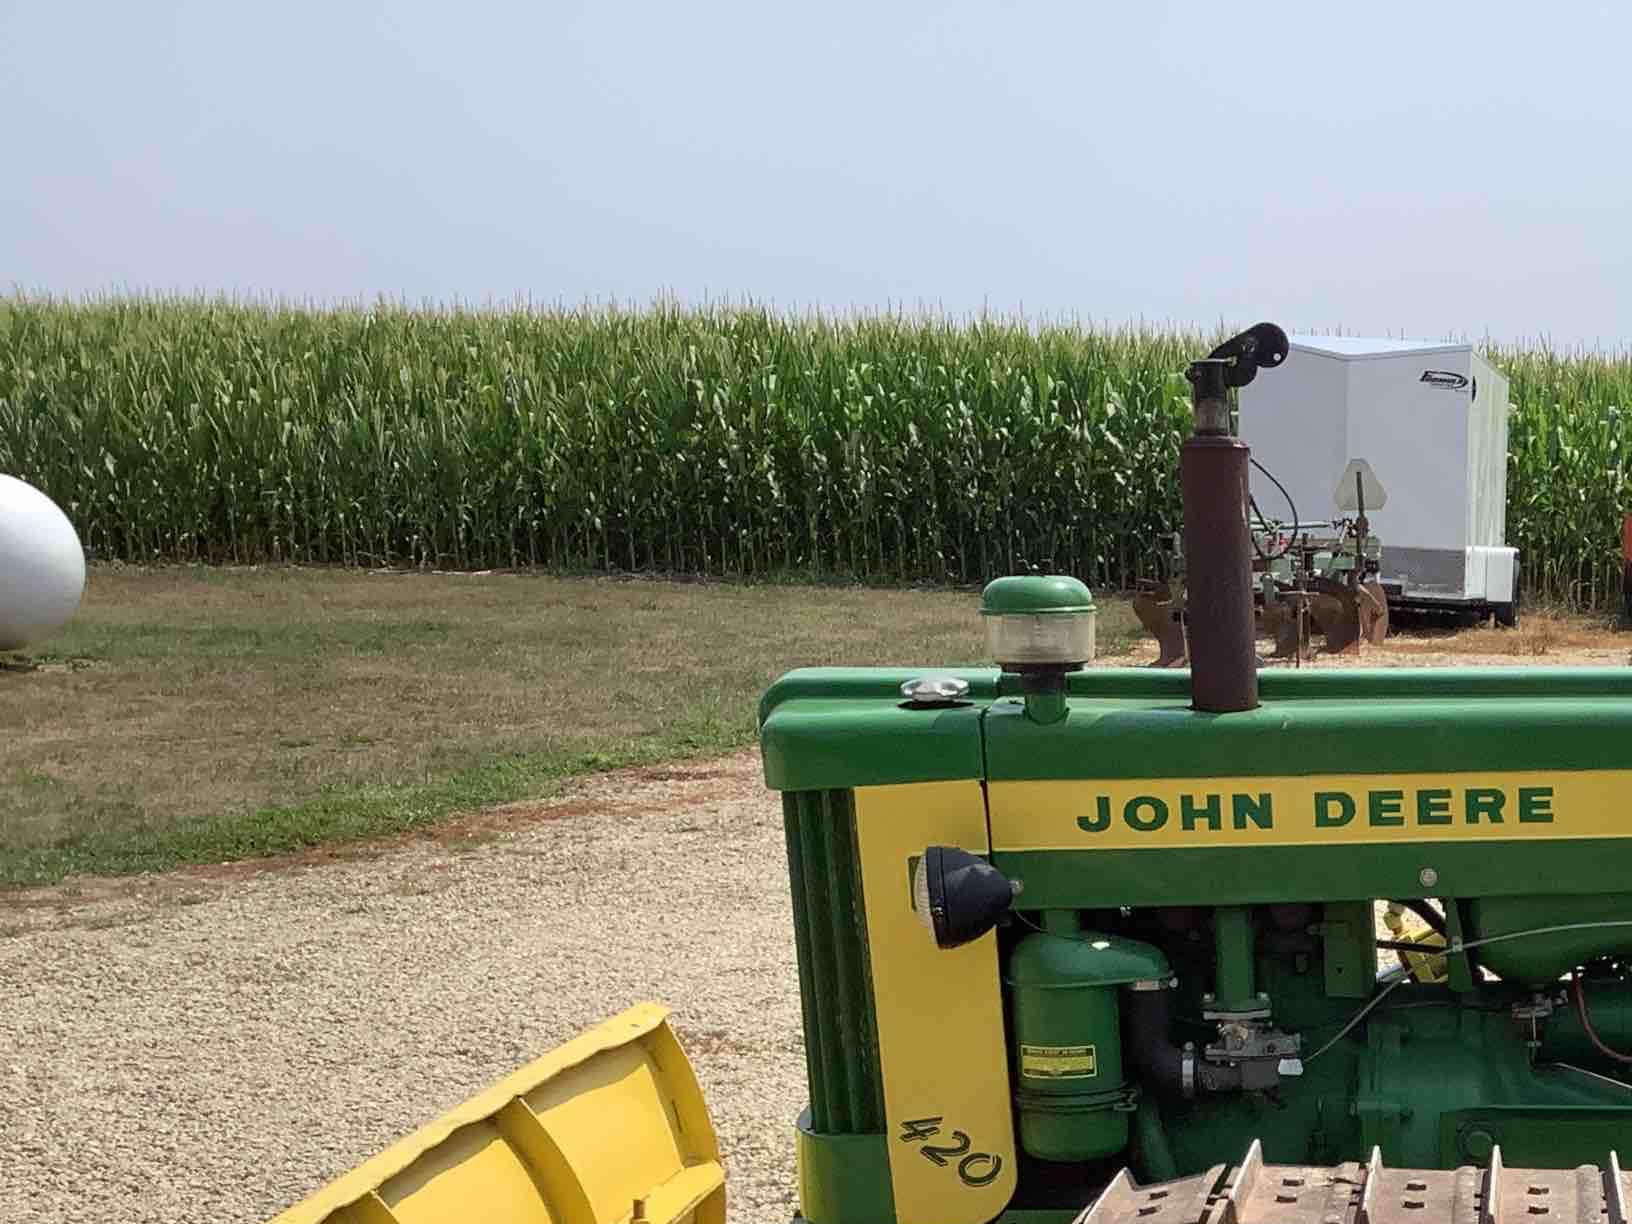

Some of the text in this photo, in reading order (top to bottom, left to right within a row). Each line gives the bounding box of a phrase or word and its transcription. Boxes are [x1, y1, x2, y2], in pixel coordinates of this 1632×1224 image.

[1076, 786, 1554, 834] JOHN DEERE
[900, 1116, 1002, 1187] 420
